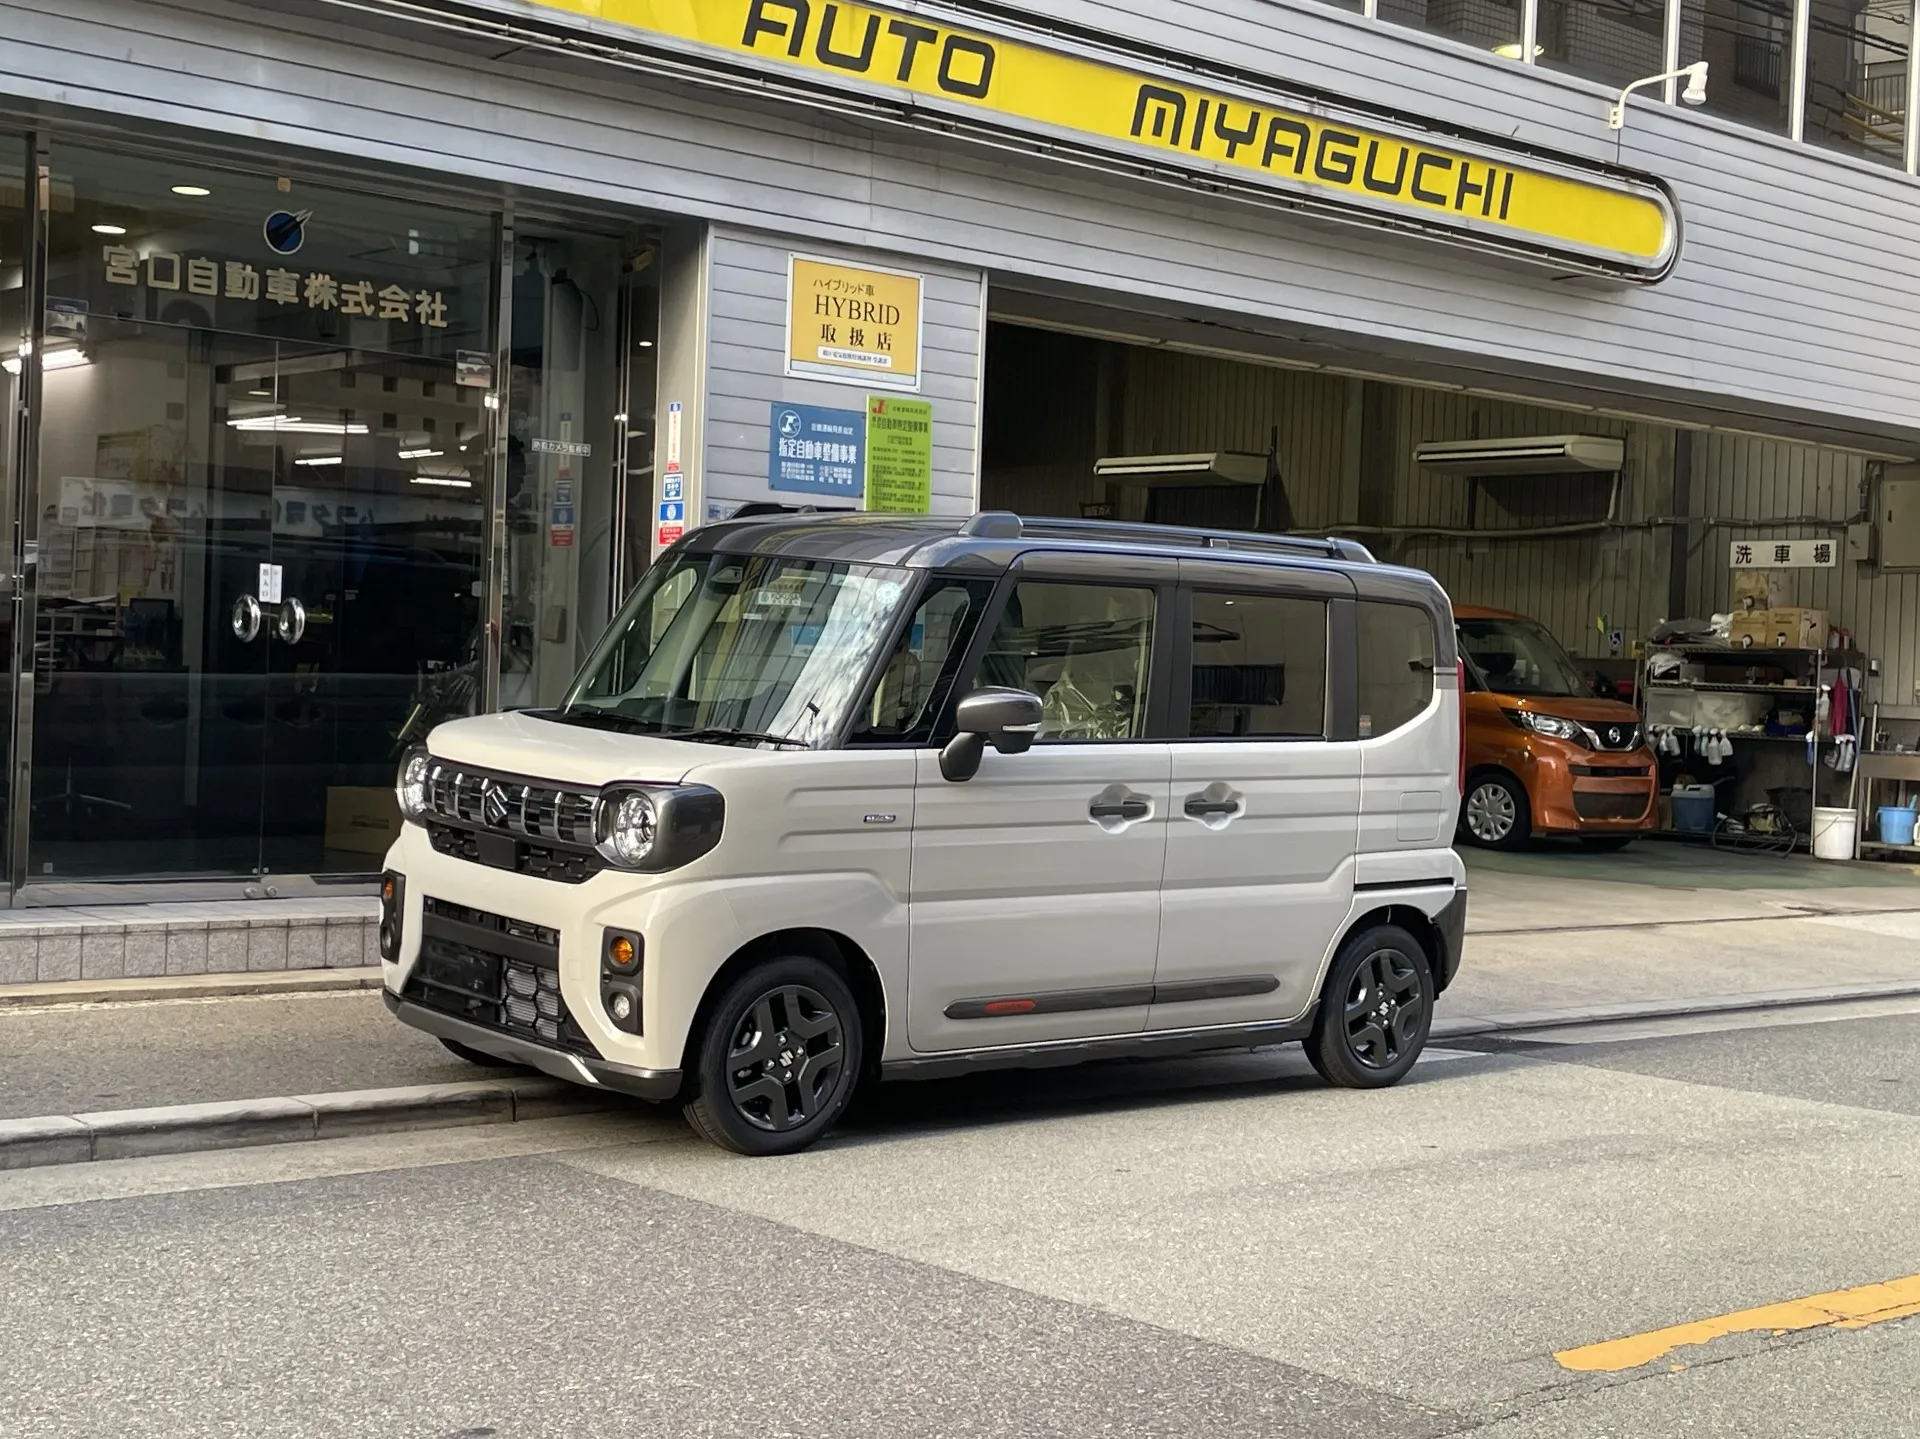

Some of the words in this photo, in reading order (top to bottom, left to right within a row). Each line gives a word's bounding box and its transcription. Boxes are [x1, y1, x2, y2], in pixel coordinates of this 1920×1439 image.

[742, 0, 996, 98] AUTO
[1130, 84, 1514, 220] MIYAGUCHI
[102, 244, 449, 329] 宮口自動車株式会社
[813, 279, 875, 297] ハイブリッド車
[815, 294, 901, 326] HYBRID
[820, 323, 893, 351] 取扱店
[1735, 543, 1831, 565] 洗車場
